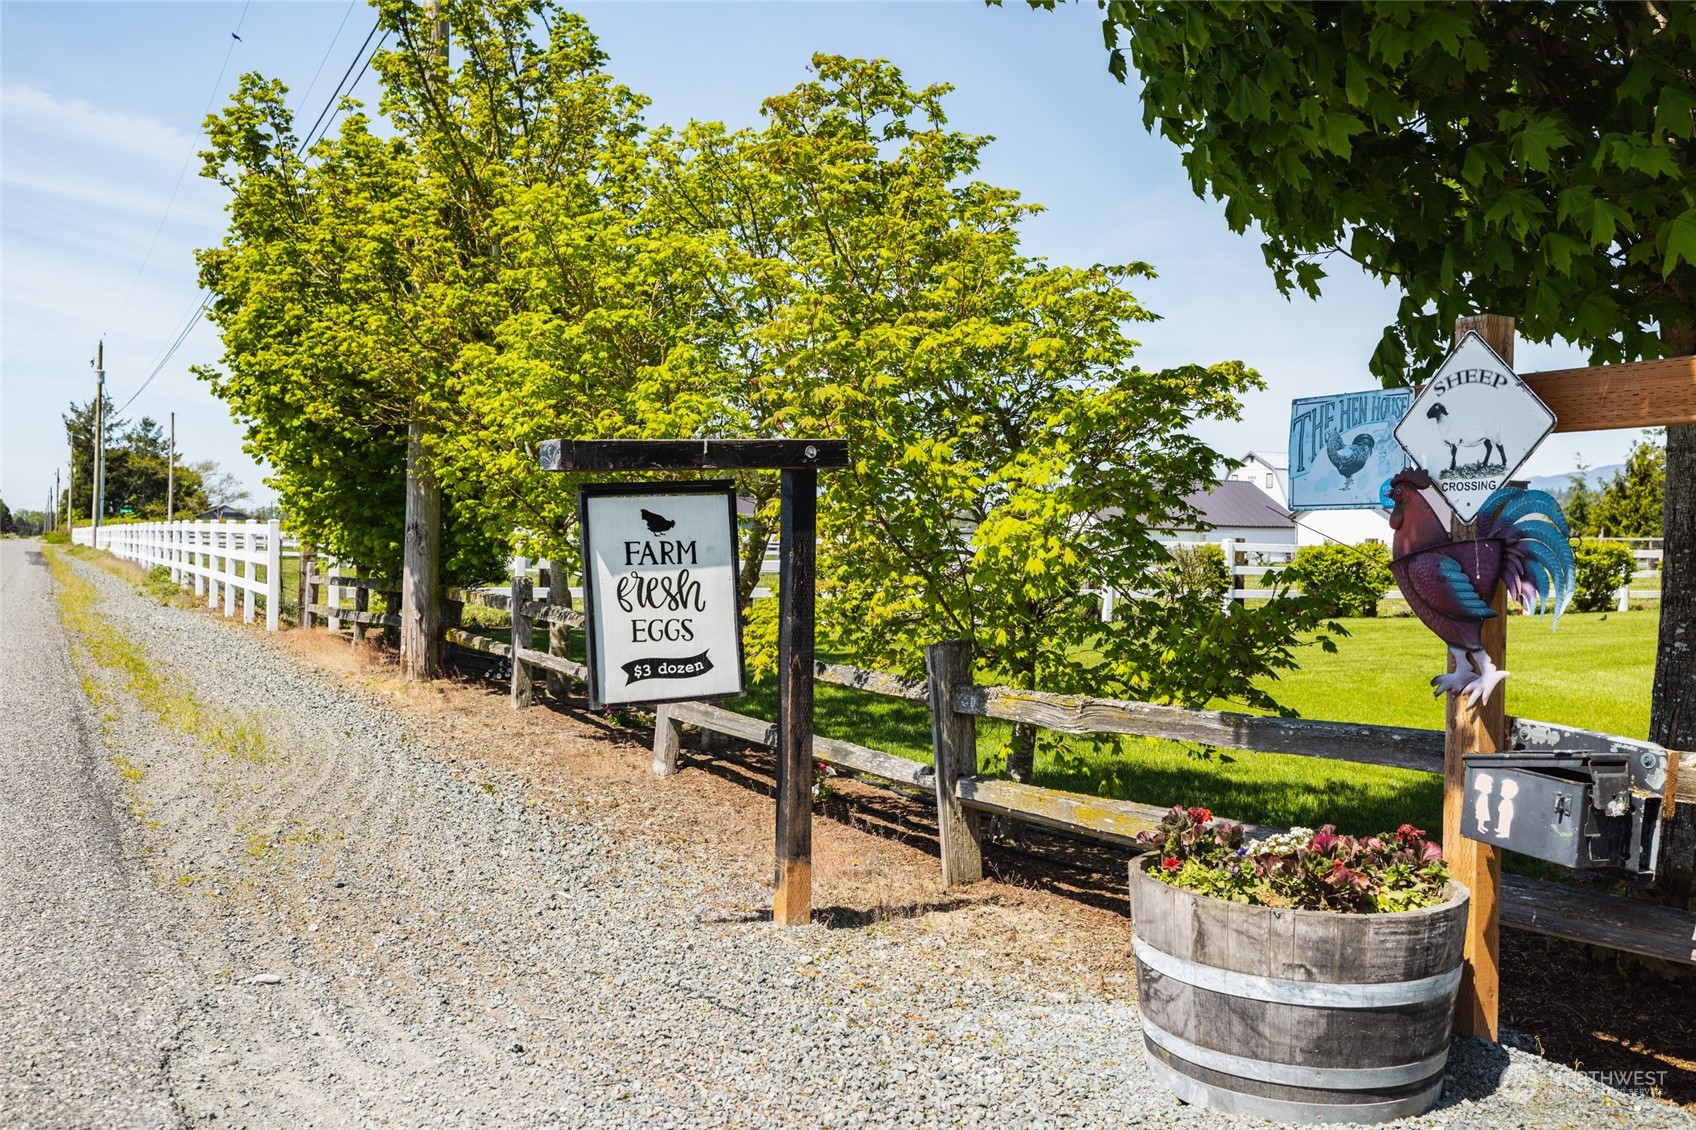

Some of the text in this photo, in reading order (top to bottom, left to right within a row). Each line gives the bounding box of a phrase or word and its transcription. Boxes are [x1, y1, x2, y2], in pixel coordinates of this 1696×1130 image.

[1433, 368, 1508, 397] SHEEP
[1292, 395, 1408, 472] THE HEN HOUSE
[1441, 480, 1497, 492] CROSSING
[624, 540, 698, 566] FARM
[616, 568, 706, 613] fresh
[631, 618, 694, 643] EGGS
[634, 661, 705, 679] $3 dozen
